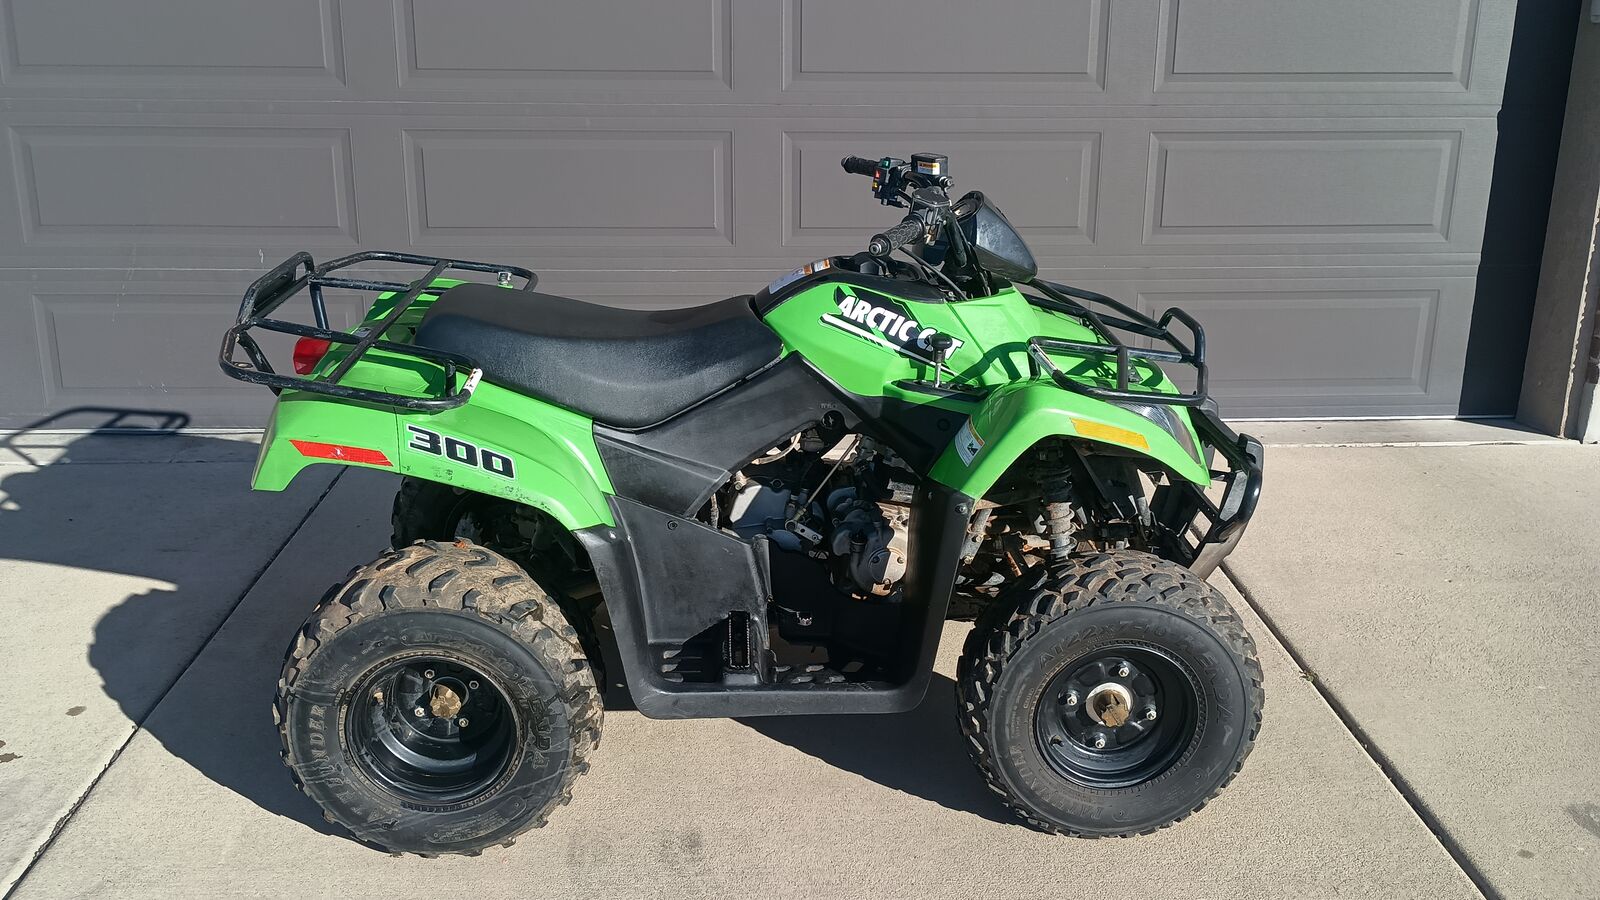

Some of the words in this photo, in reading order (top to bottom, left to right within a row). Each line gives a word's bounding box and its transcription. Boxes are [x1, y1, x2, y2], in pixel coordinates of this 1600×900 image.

[837, 295, 918, 342] ARCTIC
[917, 327, 965, 360] CT
[406, 424, 515, 480] 300
